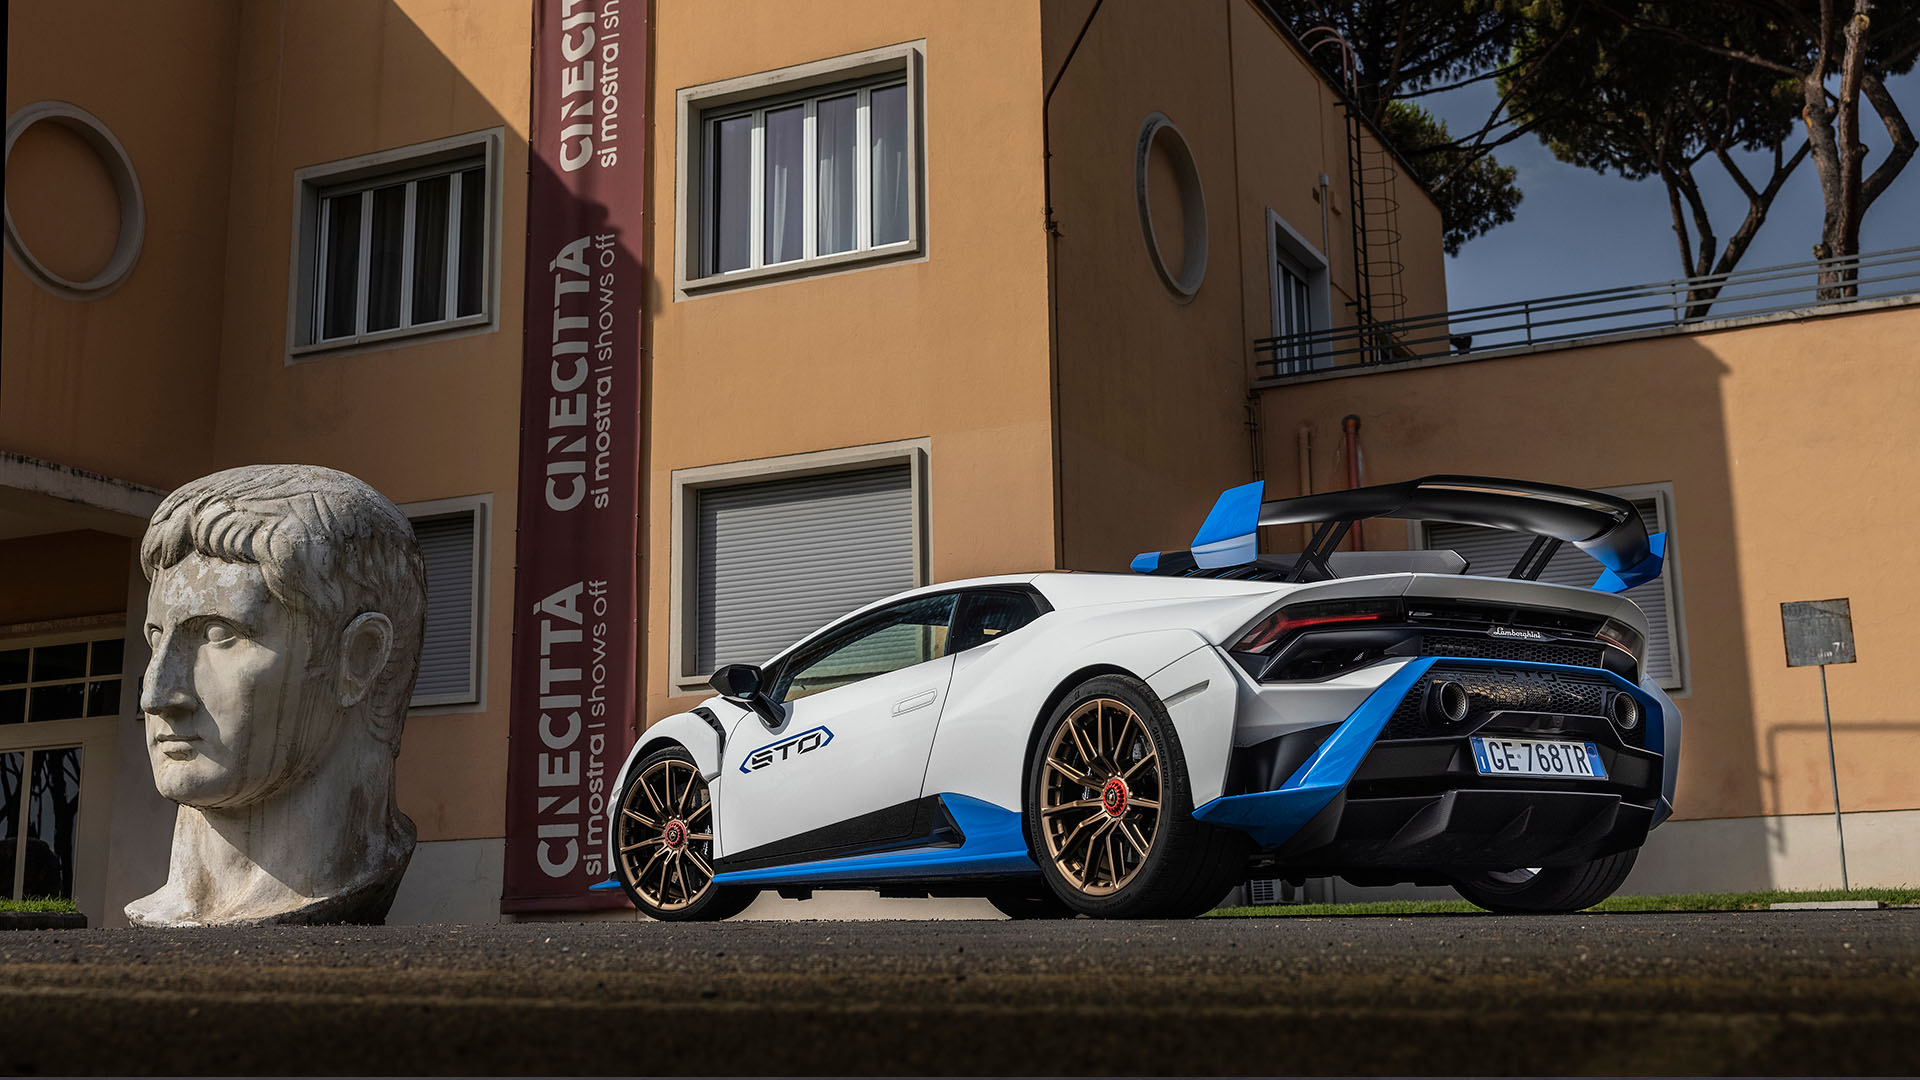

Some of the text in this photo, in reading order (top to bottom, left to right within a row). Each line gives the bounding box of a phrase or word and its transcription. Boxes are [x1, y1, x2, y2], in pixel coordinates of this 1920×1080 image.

[600, 42, 619, 142] mostra
[597, 146, 617, 168] si
[595, 232, 616, 268] off
[594, 272, 614, 361] shows
[545, 235, 591, 512] CINECITTÀ
[593, 375, 612, 481] mostra
[590, 487, 609, 509] si
[588, 579, 608, 617] off
[1493, 626, 1541, 639] Lamborghini
[587, 622, 607, 717] shows
[533, 581, 584, 878] CINECITTÀ
[751, 731, 822, 770] STO
[586, 733, 605, 845] mostra
[583, 852, 602, 876] si
